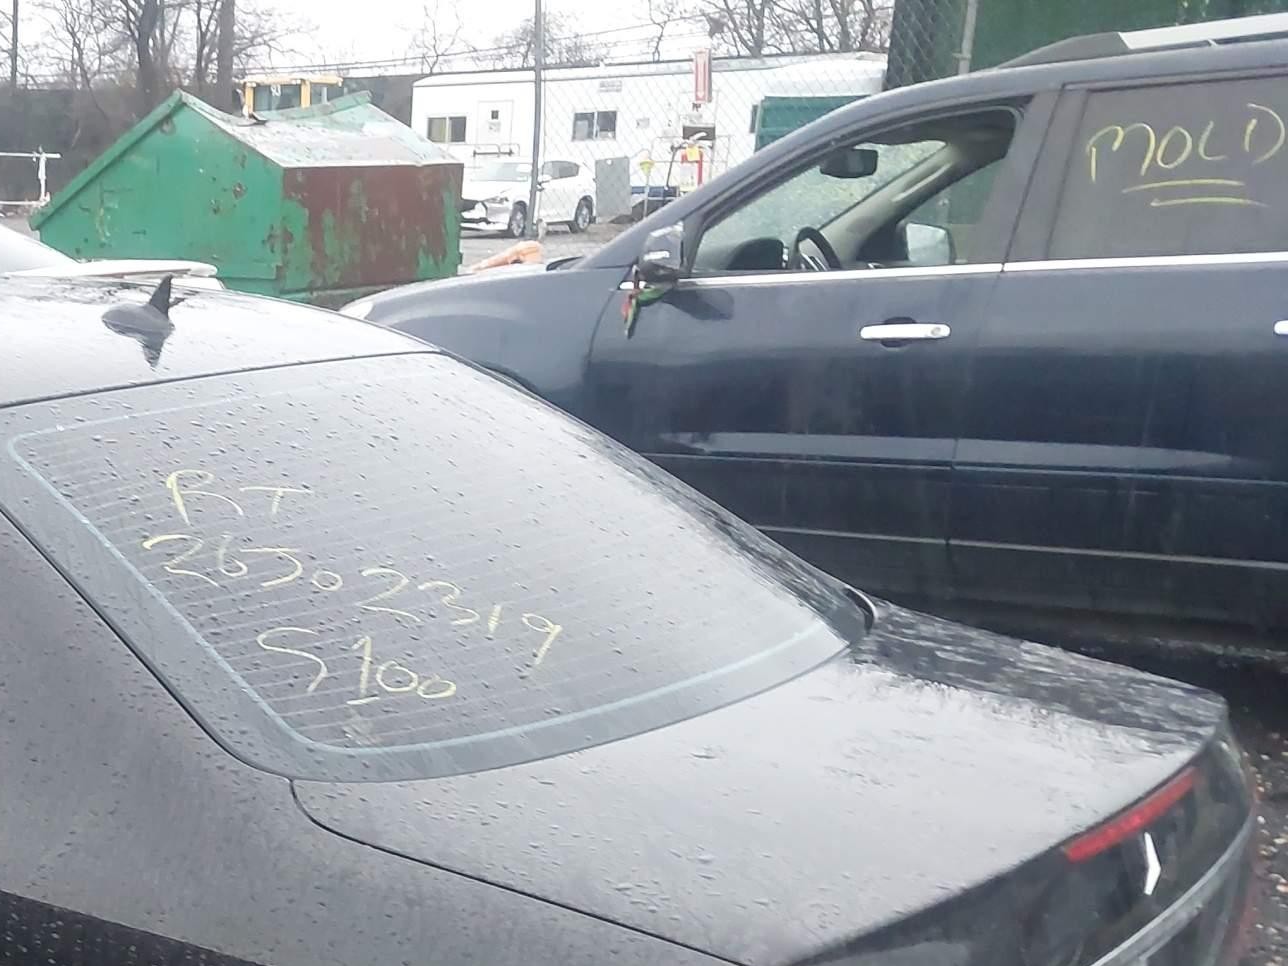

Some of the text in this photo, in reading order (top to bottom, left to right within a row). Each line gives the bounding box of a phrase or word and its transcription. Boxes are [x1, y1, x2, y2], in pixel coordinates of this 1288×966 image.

[1085, 102, 1286, 183] MOLD
[142, 533, 564, 666] 26502319
[257, 627, 457, 705] S100
